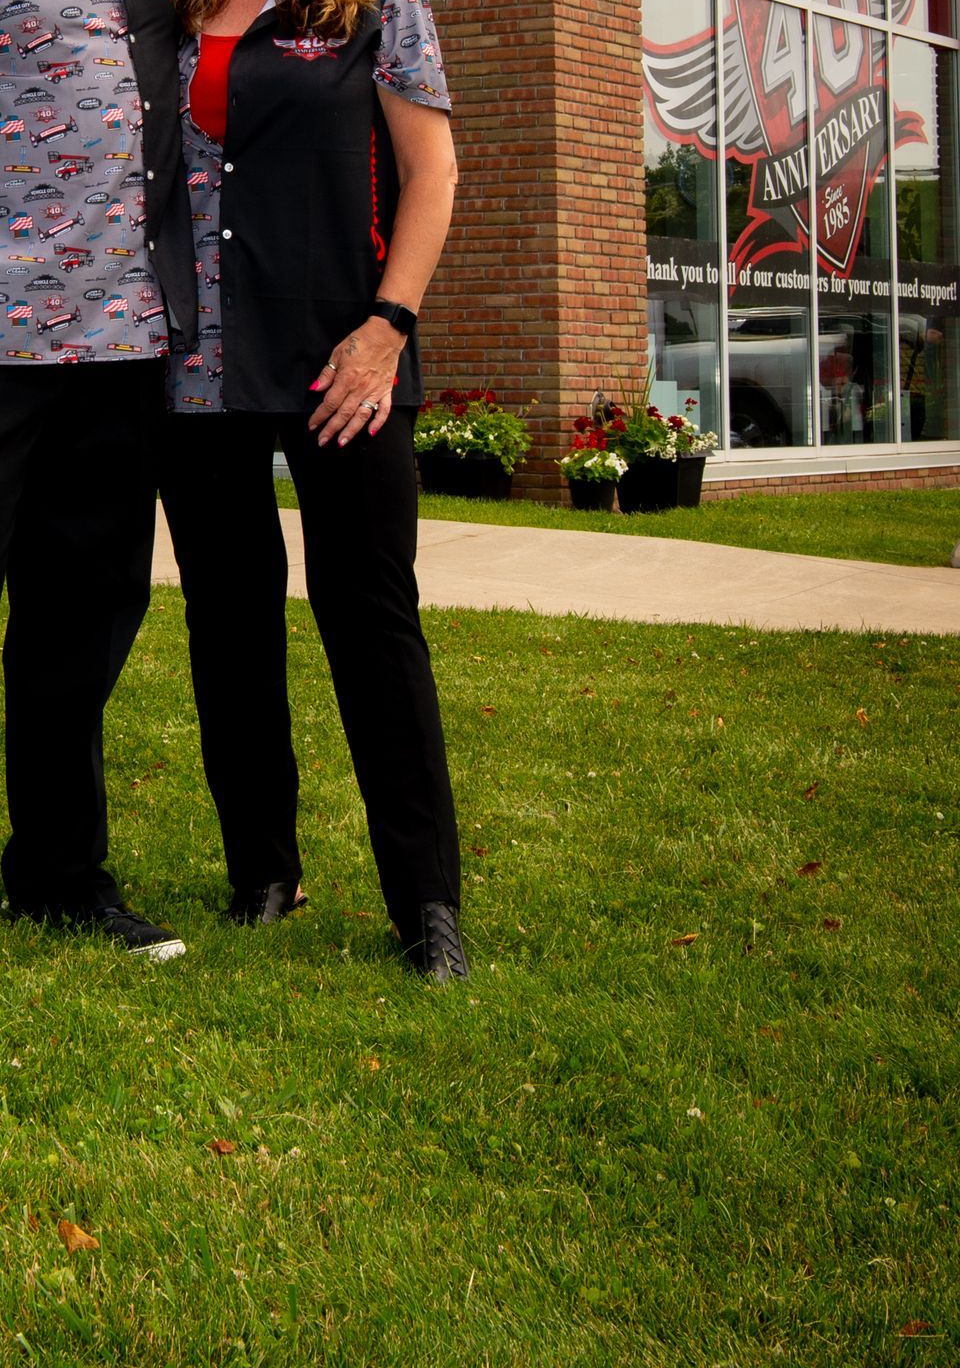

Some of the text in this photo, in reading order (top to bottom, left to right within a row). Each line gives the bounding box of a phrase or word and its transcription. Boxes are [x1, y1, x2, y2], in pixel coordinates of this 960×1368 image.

[298, 36, 325, 49] 40
[763, 90, 882, 201] ANNIERSARY
[823, 197, 851, 241] 1985
[824, 186, 843, 209] Since
[645, 254, 957, 306] hank you to ll of our customrs for your connued support!
